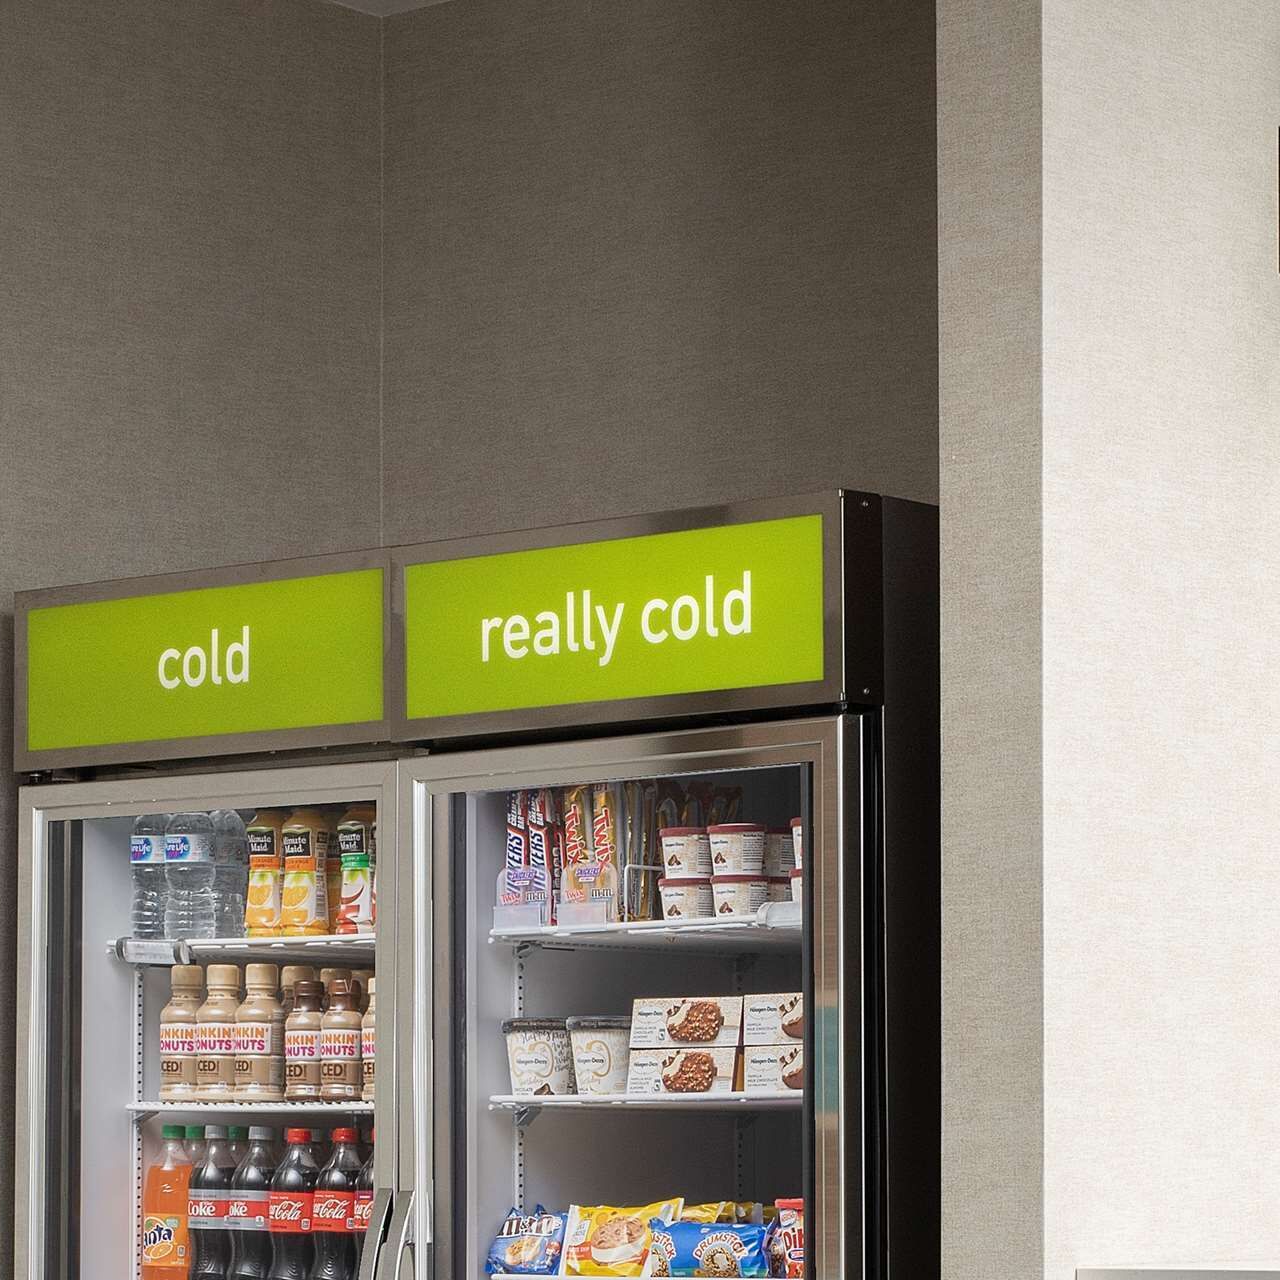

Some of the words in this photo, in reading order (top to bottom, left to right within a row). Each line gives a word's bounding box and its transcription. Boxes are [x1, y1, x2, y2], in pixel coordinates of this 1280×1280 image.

[158, 626, 250, 690] cold
[481, 589, 625, 667] really
[642, 571, 753, 642] cold
